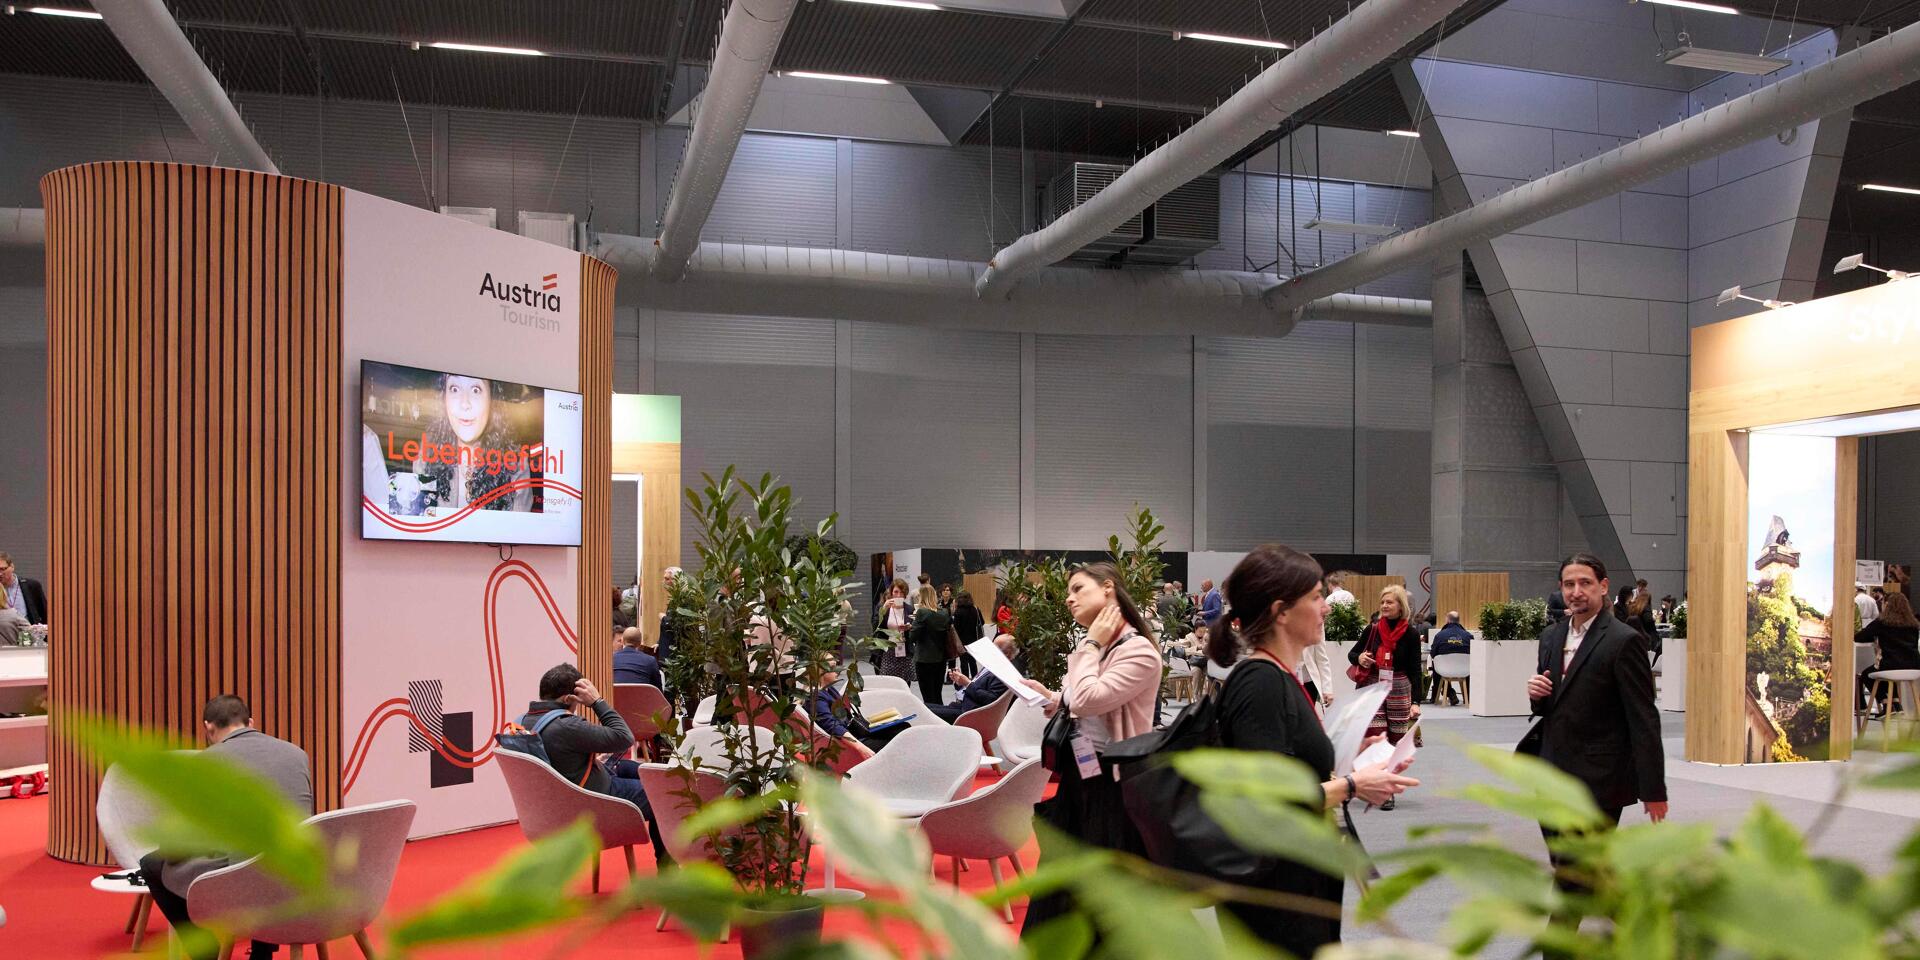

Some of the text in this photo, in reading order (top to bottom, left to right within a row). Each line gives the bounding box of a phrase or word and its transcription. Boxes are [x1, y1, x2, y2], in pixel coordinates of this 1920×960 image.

[479, 273, 561, 313] Austria
[500, 305, 561, 333] Tourism
[558, 401, 578, 412] Austria
